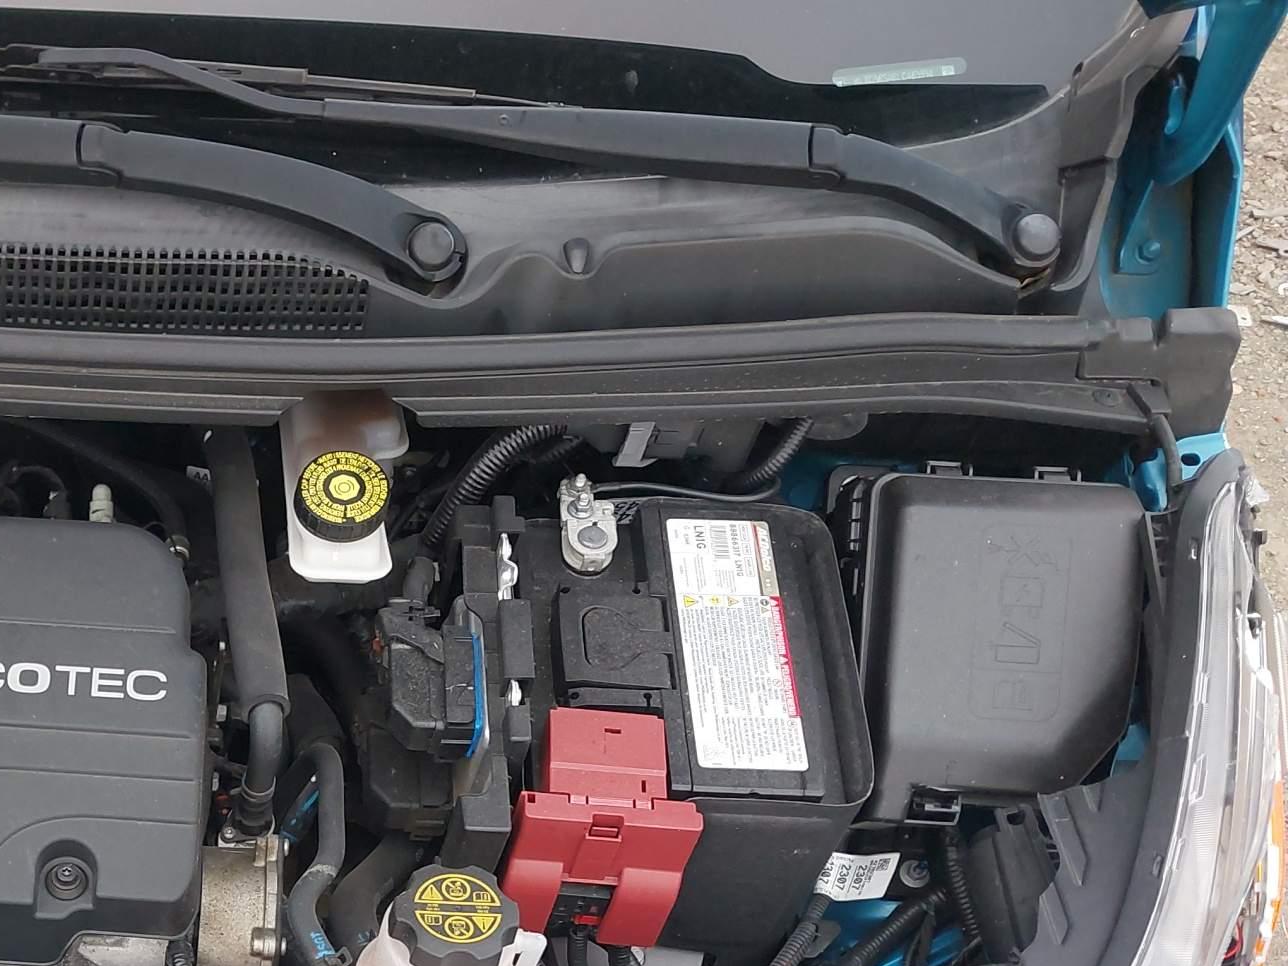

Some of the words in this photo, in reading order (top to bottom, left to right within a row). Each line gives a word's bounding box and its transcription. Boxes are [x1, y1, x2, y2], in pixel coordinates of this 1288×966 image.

[693, 525, 706, 549] LN1G
[835, 864, 852, 891] 2307
[852, 864, 868, 890] 2307
